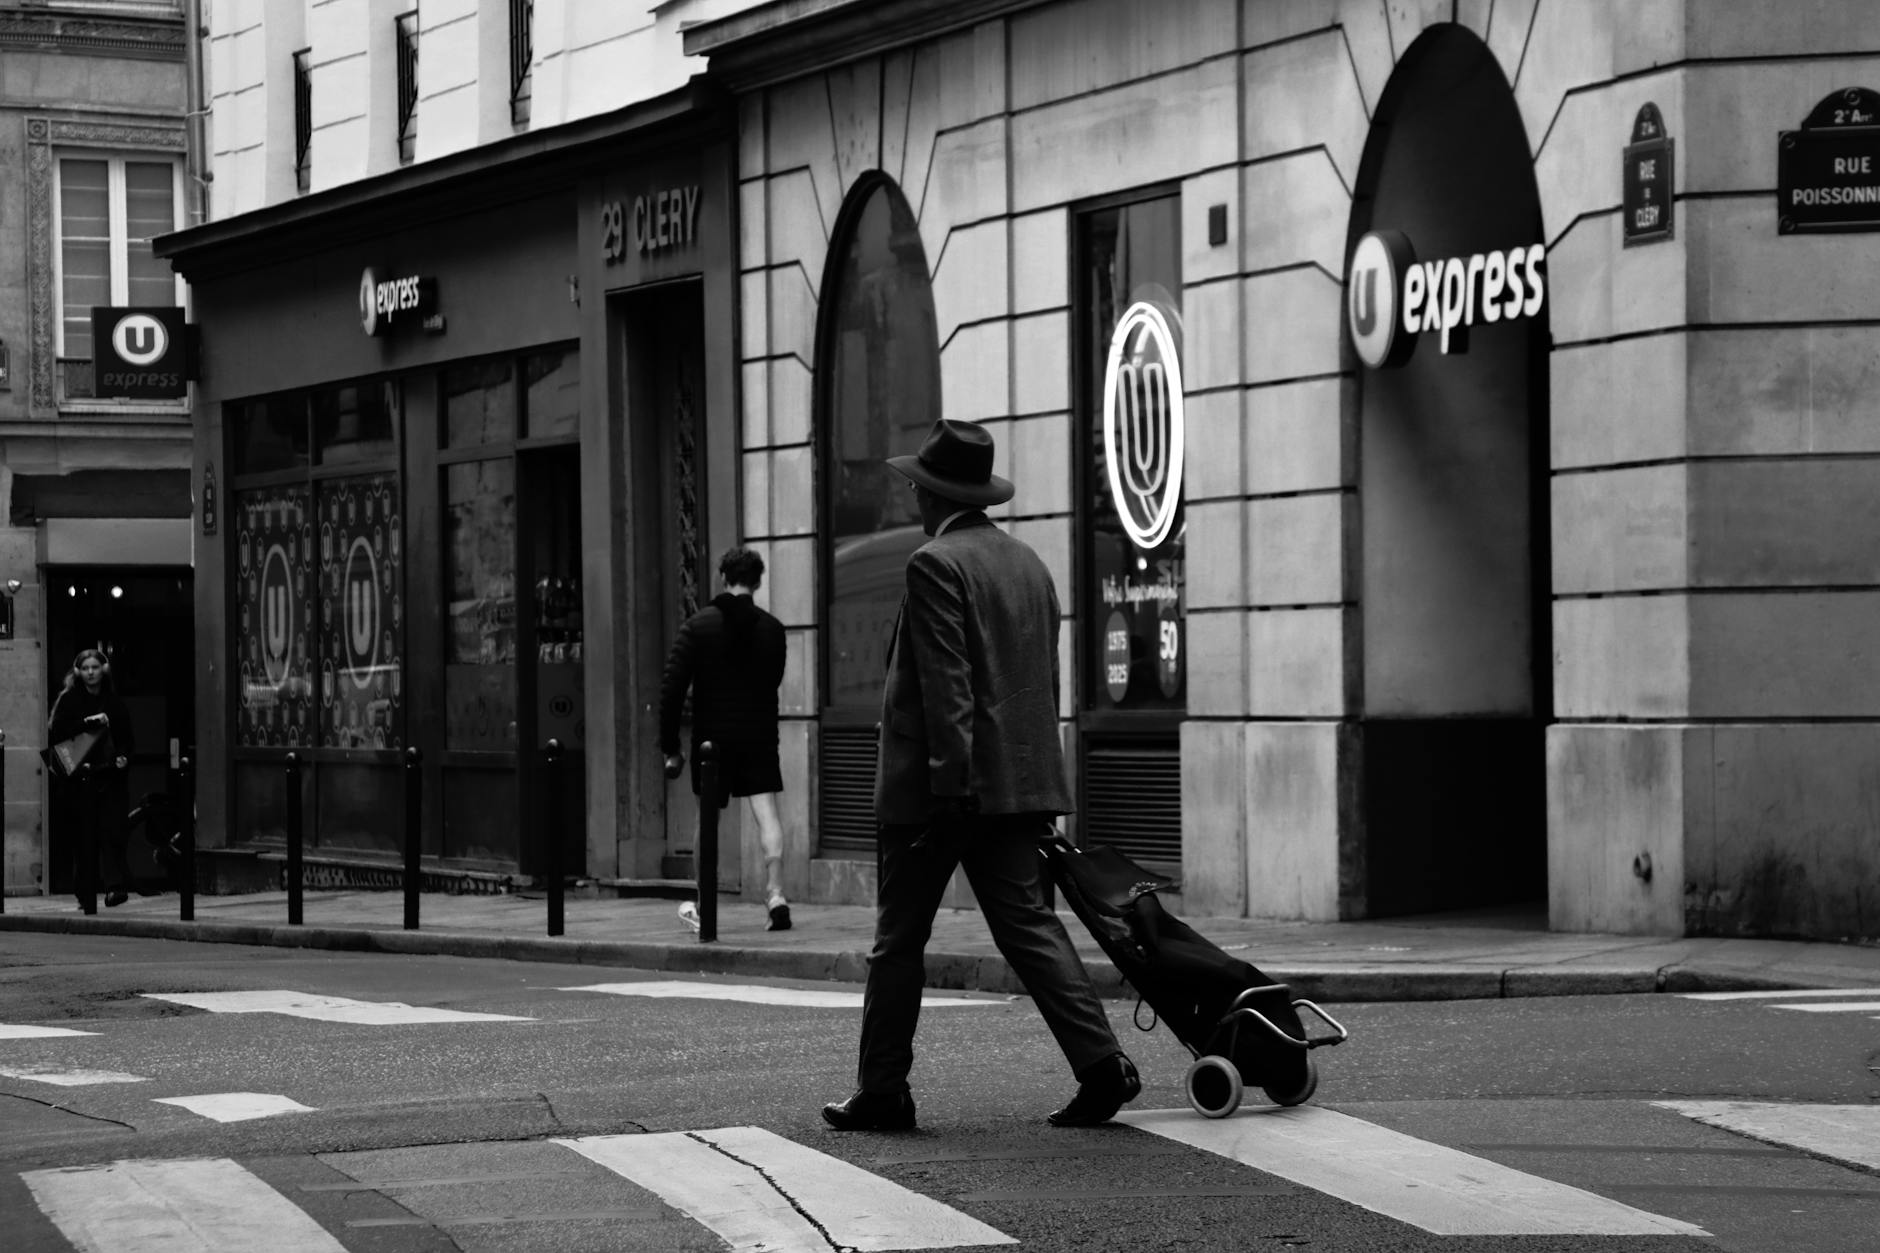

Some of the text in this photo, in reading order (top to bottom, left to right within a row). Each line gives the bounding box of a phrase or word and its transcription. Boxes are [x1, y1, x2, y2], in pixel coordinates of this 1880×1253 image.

[1639, 159, 1656, 180] RUE
[1834, 156, 1872, 174] RUE
[600, 185, 699, 259] 29 CLERY
[377, 275, 420, 323] express
[1402, 243, 1545, 355] express
[125, 327, 155, 354] U
[103, 372, 180, 390] express
[267, 586, 286, 659] U
[352, 580, 369, 655] U
[1160, 620, 1178, 660] 50
